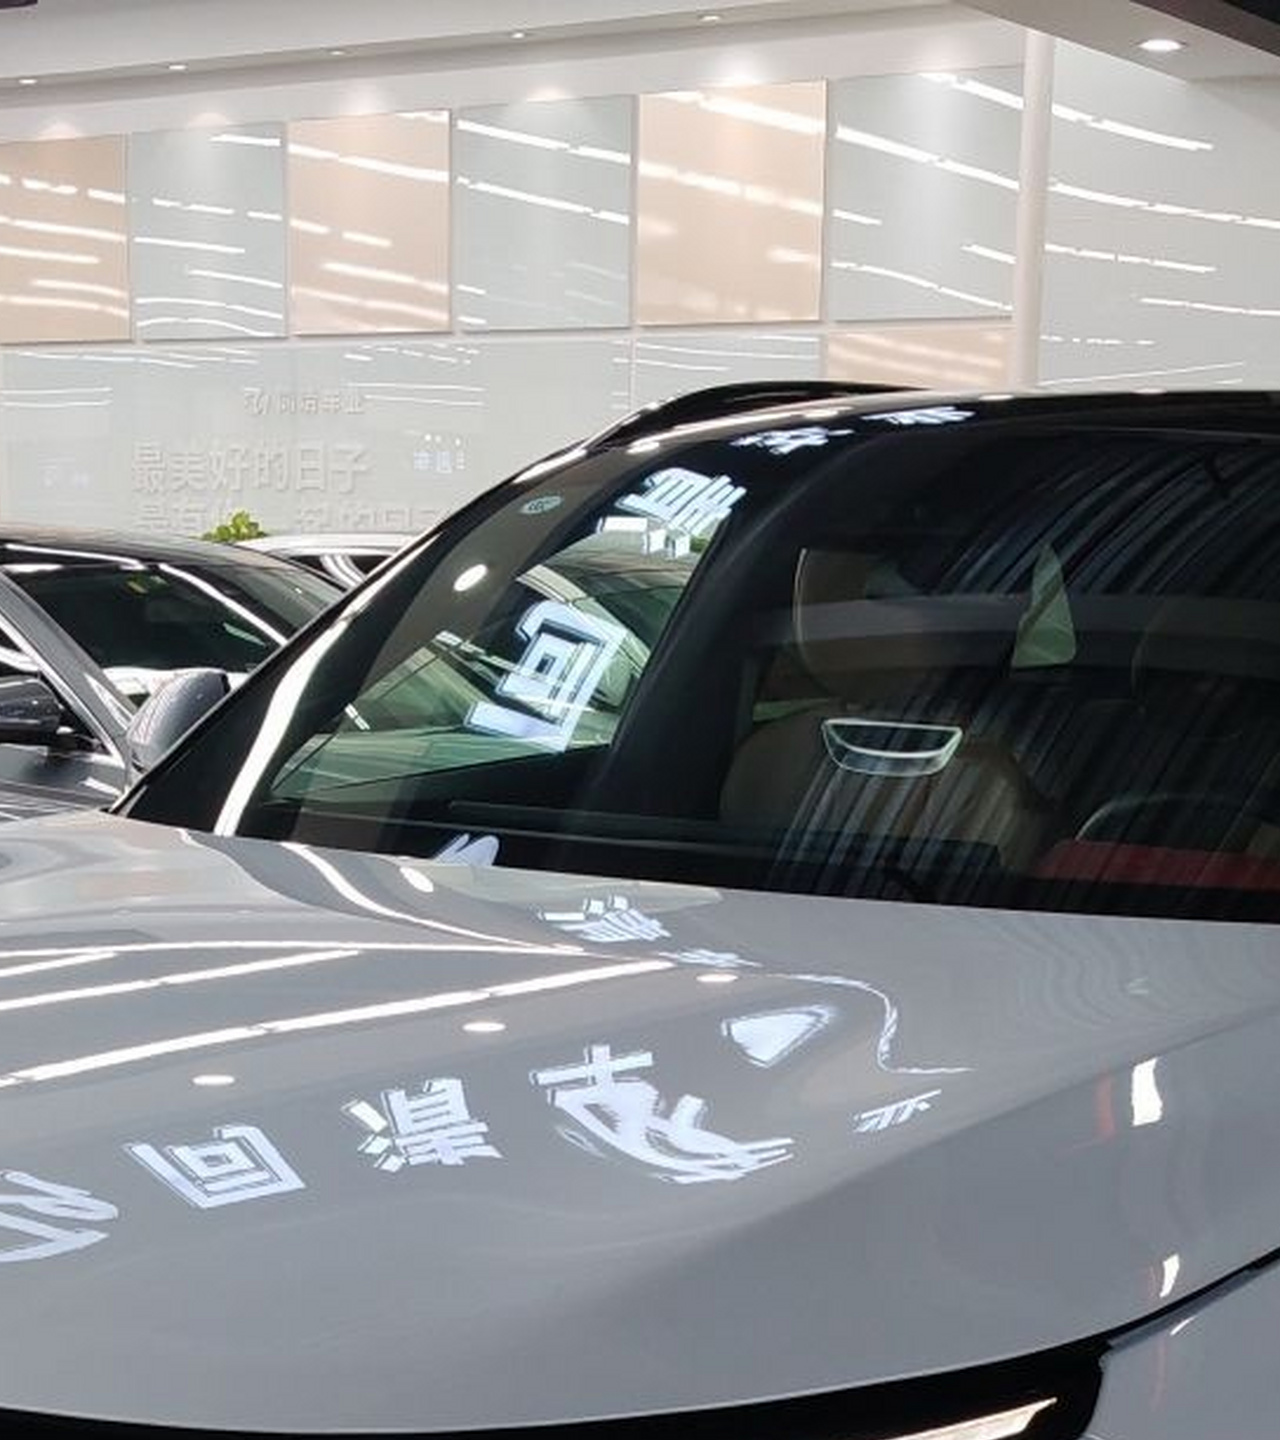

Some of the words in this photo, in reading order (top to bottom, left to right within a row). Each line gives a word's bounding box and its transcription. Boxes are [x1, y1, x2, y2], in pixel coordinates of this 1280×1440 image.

[131, 440, 372, 493] 最美好的日子
